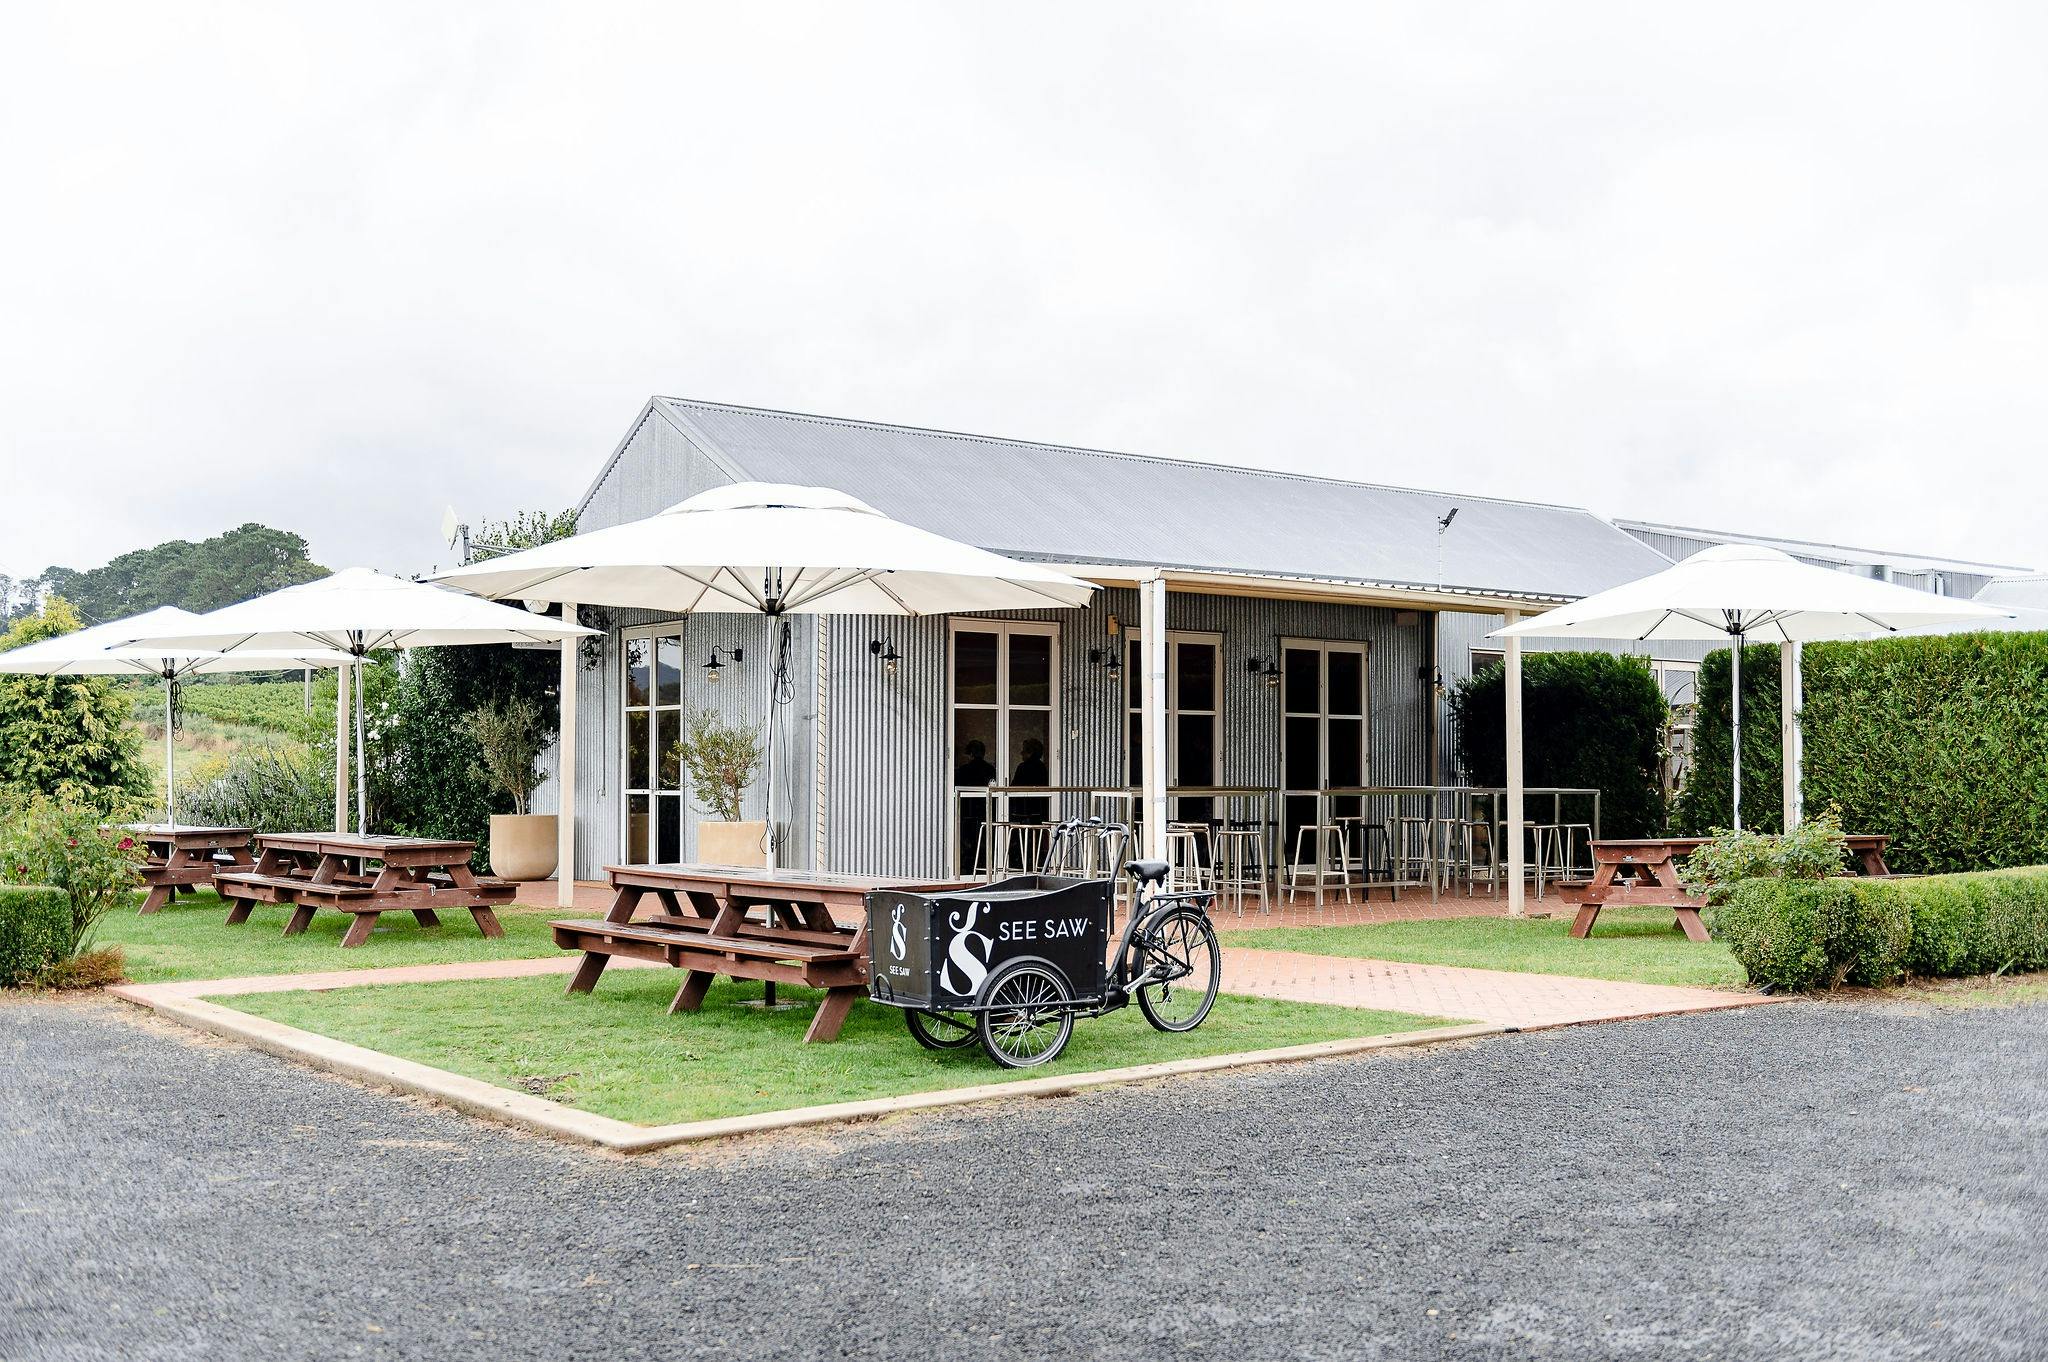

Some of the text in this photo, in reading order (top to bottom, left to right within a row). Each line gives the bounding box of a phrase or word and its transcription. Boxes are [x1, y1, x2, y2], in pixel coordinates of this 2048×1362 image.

[999, 918, 1088, 941] SEE SAW
[889, 965, 911, 977] SEE SAW
